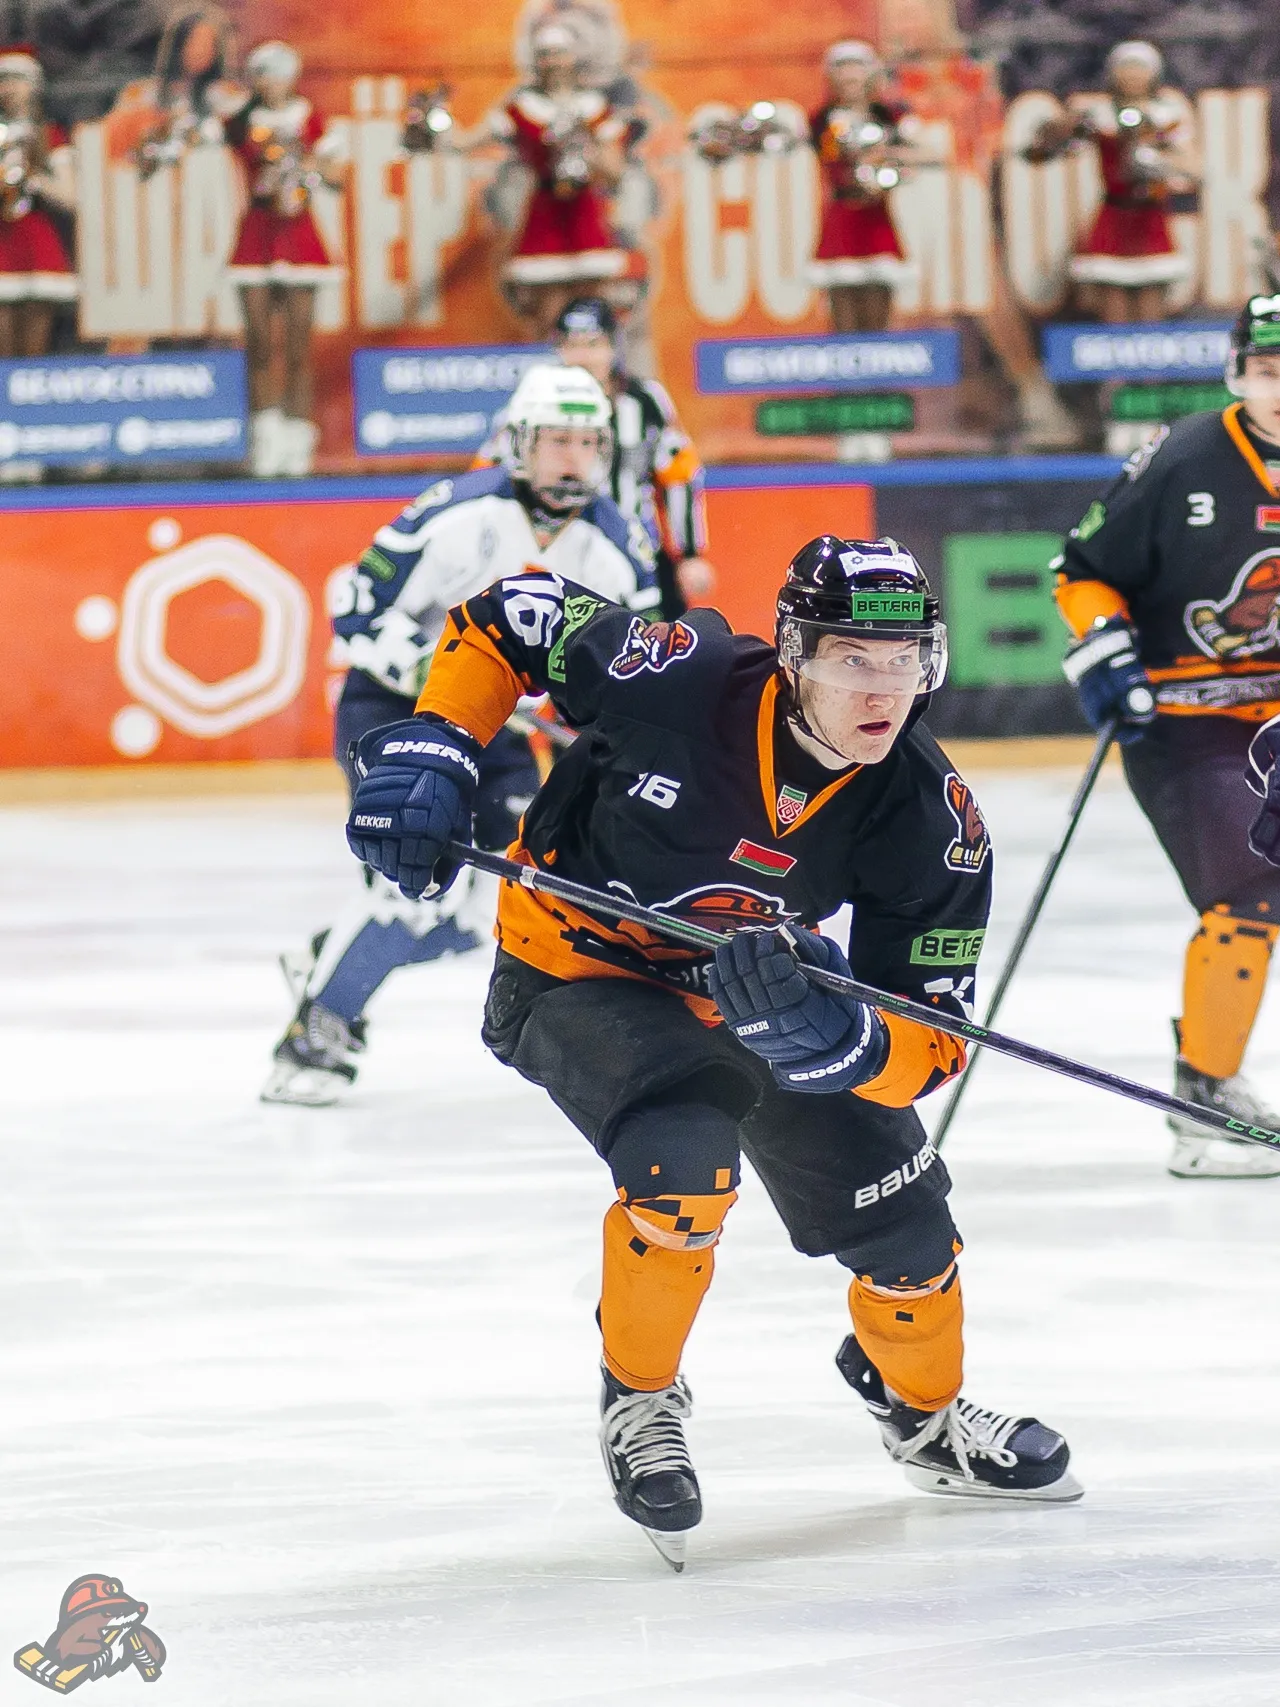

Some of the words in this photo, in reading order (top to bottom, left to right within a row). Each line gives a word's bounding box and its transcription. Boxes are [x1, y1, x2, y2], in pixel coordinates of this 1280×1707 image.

[1187, 491, 1215, 526] 3
[778, 600, 794, 613] CCM
[857, 600, 921, 613] BETERA
[628, 772, 682, 809] 16
[355, 815, 393, 829] REKKER
[919, 935, 983, 960] BETE
[736, 1019, 769, 1037] REKKER
